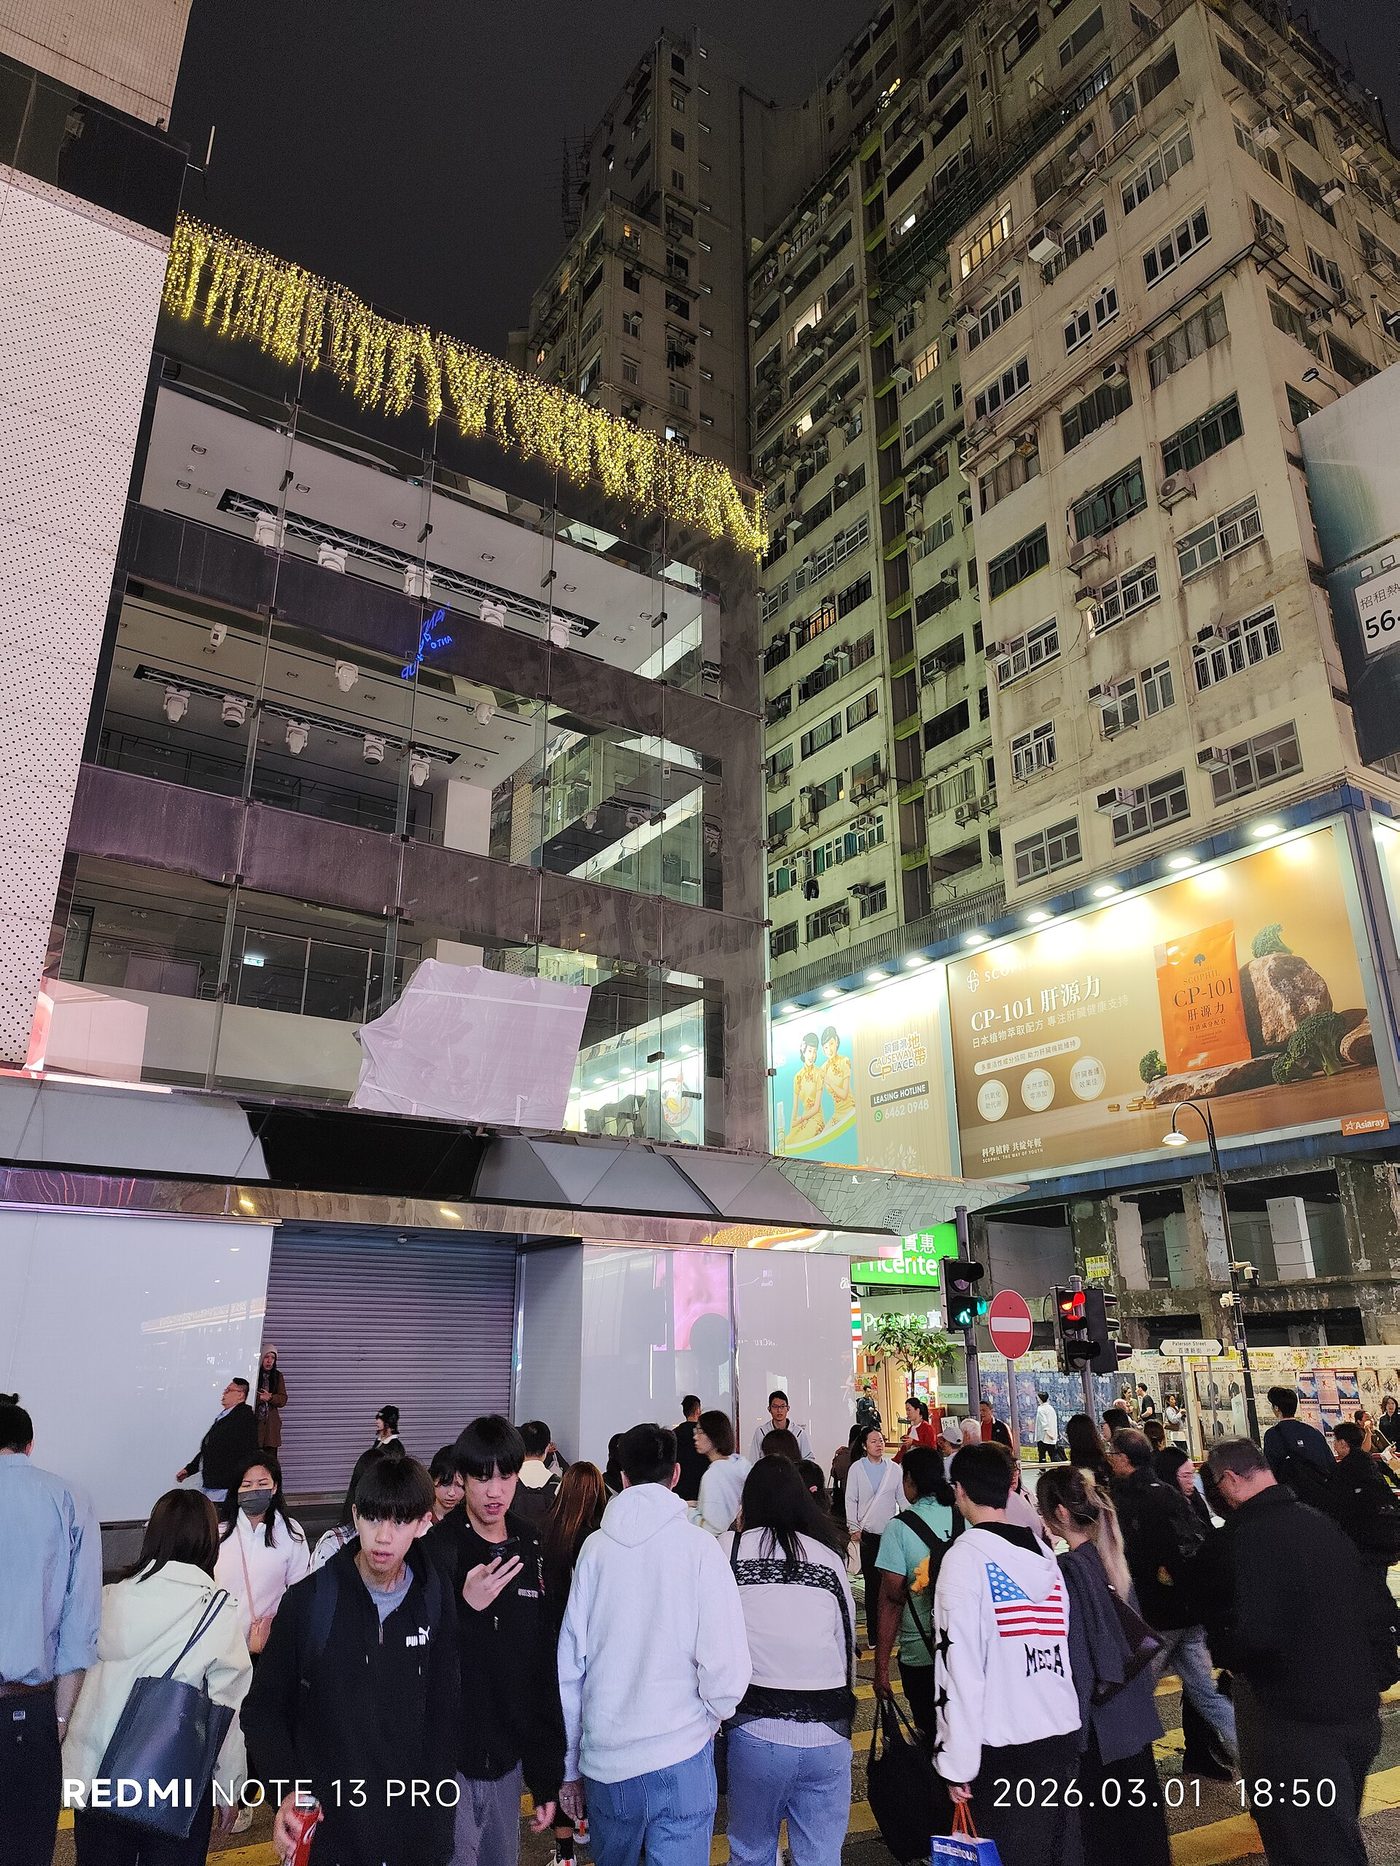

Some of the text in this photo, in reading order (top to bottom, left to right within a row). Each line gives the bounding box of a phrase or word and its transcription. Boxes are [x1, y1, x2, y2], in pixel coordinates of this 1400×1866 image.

[1365, 609, 1400, 639] 56
[971, 975, 1102, 1032] CP-101 肝源力
[1174, 977, 1234, 1008] CP-101
[1187, 1001, 1224, 1021] 肝源力
[972, 1019, 1045, 1048] 日本植物萃取配方
[873, 1084, 926, 1105] LEASING HOTLINE
[884, 1099, 929, 1119] 6462 0948
[1355, 1119, 1385, 1130] Asiaray
